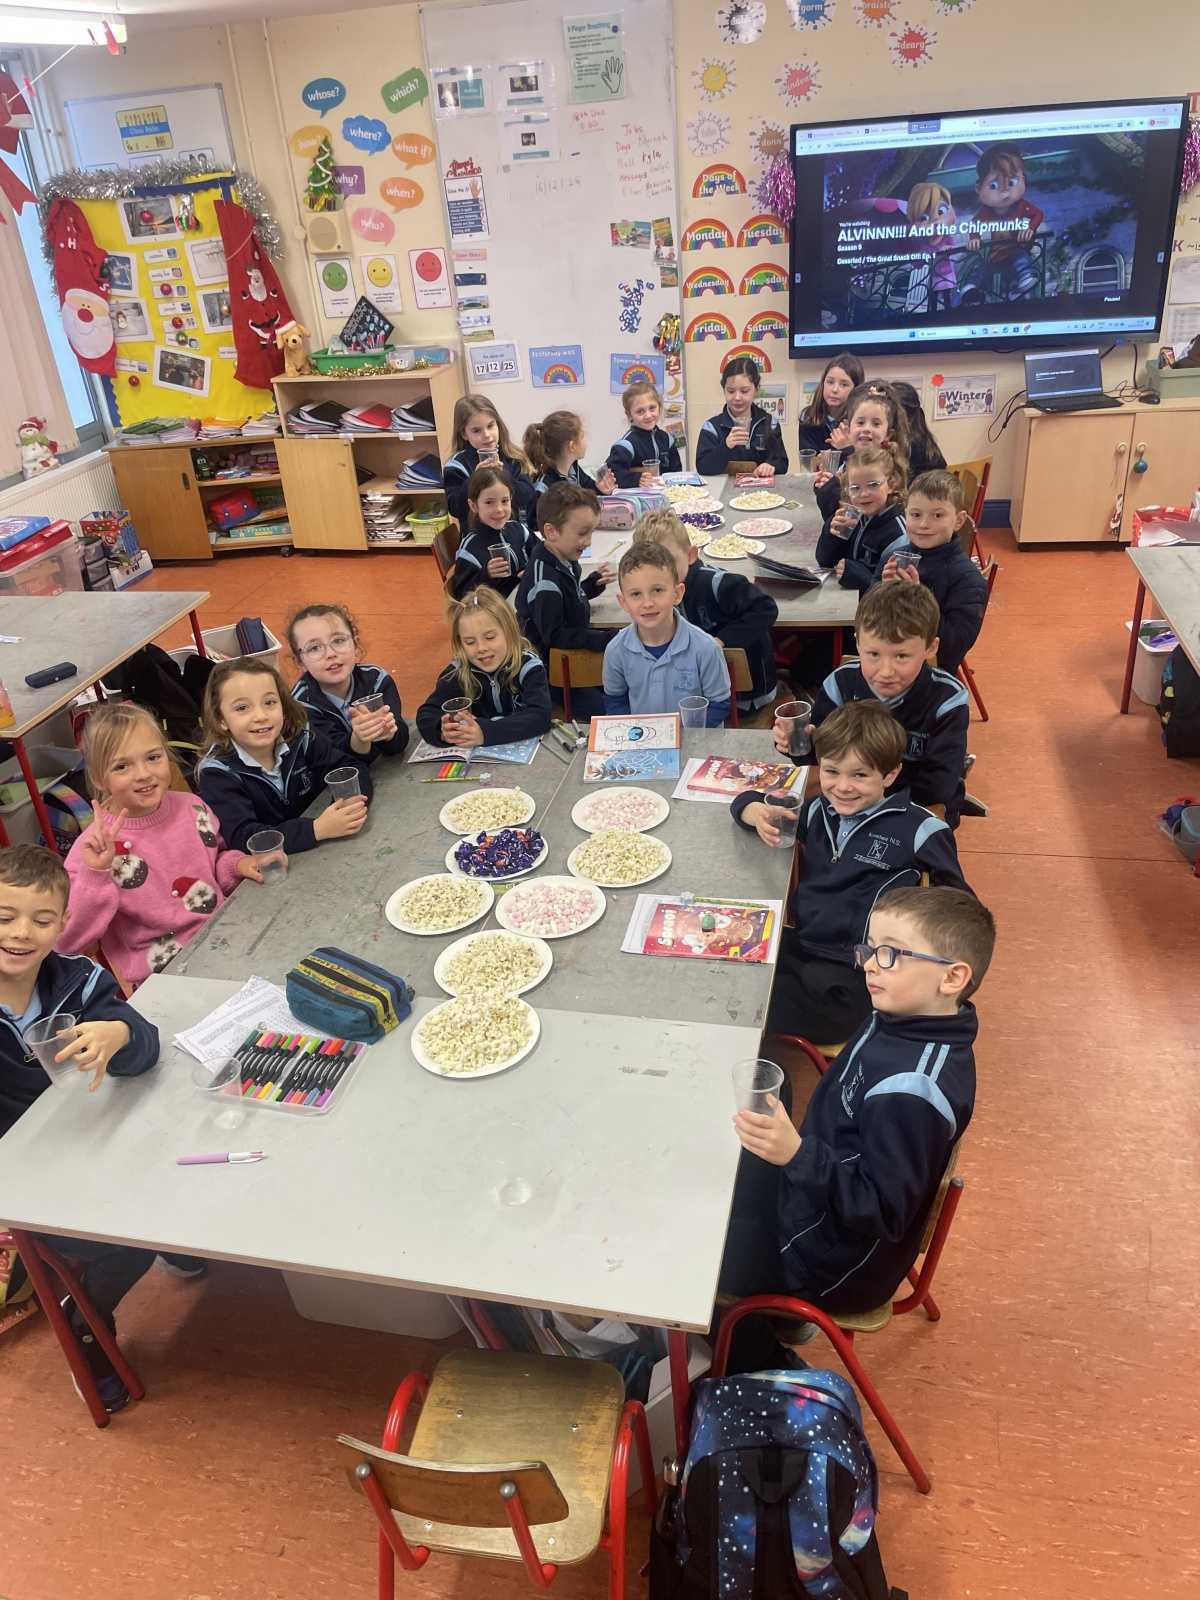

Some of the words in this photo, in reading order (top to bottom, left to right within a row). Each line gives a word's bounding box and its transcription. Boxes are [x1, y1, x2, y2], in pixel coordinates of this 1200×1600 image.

[801, 4, 823, 13] gorm
[308, 87, 340, 102] whose?
[390, 78, 420, 103] which?
[350, 127, 382, 141] where?
[335, 174, 358, 187] why?
[703, 174, 726, 184] Days
[727, 170, 737, 182] of
[386, 186, 415, 198] when?
[360, 218, 384, 231] who?
[837, 225, 907, 242] ALVINNN!!!
[908, 223, 934, 238] And
[936, 223, 957, 235] the
[959, 217, 1030, 236] Chipmunks
[686, 229, 728, 242] Monday
[743, 226, 785, 238] Tuesday
[837, 244, 858, 252] Season
[866, 255, 877, 263] The
[687, 279, 729, 290] Wednesday
[744, 275, 788, 288] Thsday
[695, 322, 727, 335] Friday
[747, 321, 789, 334] Saturday
[945, 391, 986, 401] Winter
